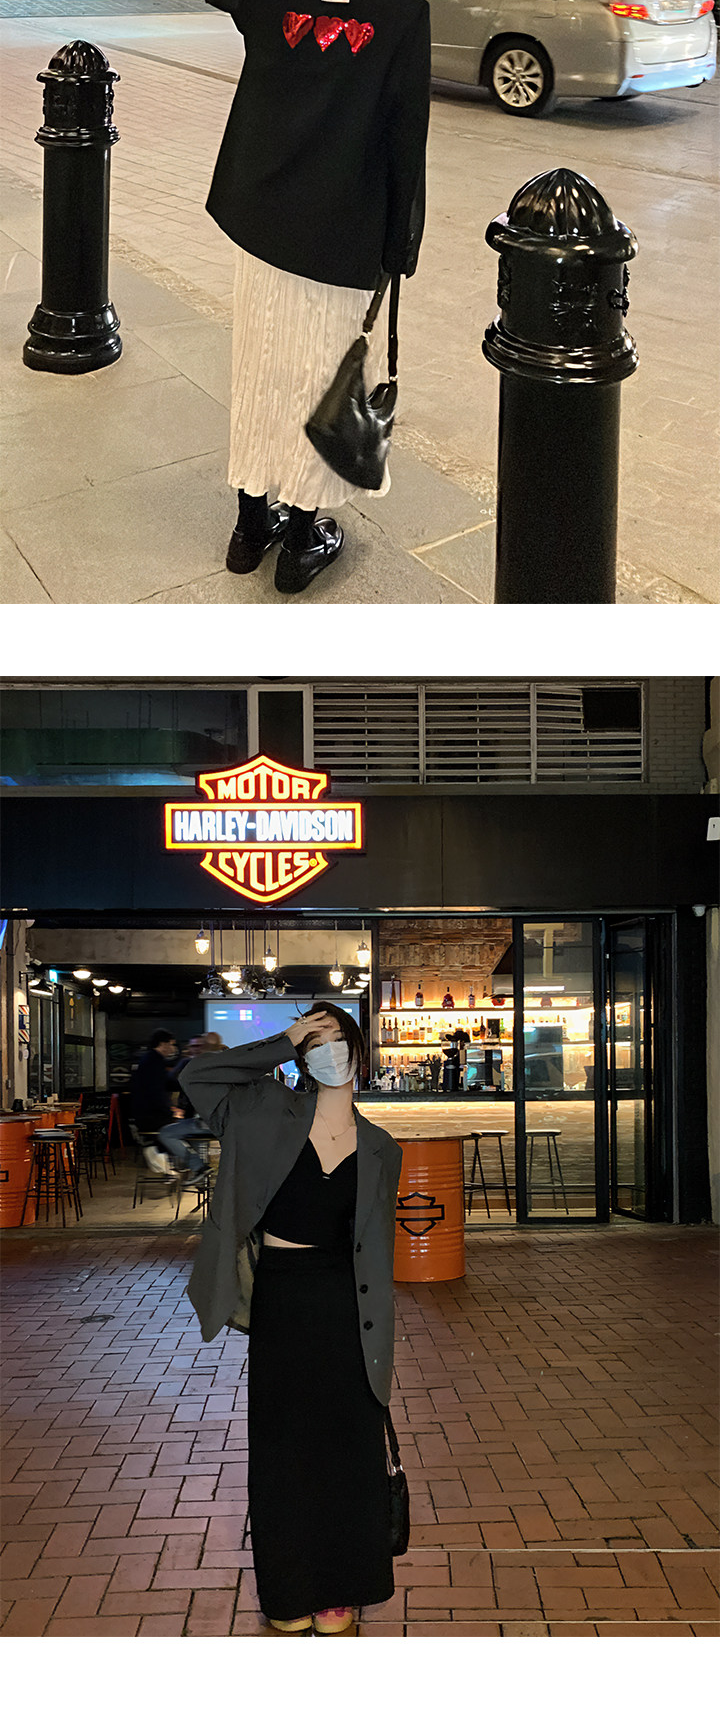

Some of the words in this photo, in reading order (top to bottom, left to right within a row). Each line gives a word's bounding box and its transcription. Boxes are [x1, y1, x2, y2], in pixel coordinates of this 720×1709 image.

[217, 765, 310, 800] MOTOR
[174, 810, 353, 842] HARLEY-DAVIDSON
[218, 851, 310, 892] CYCLES
